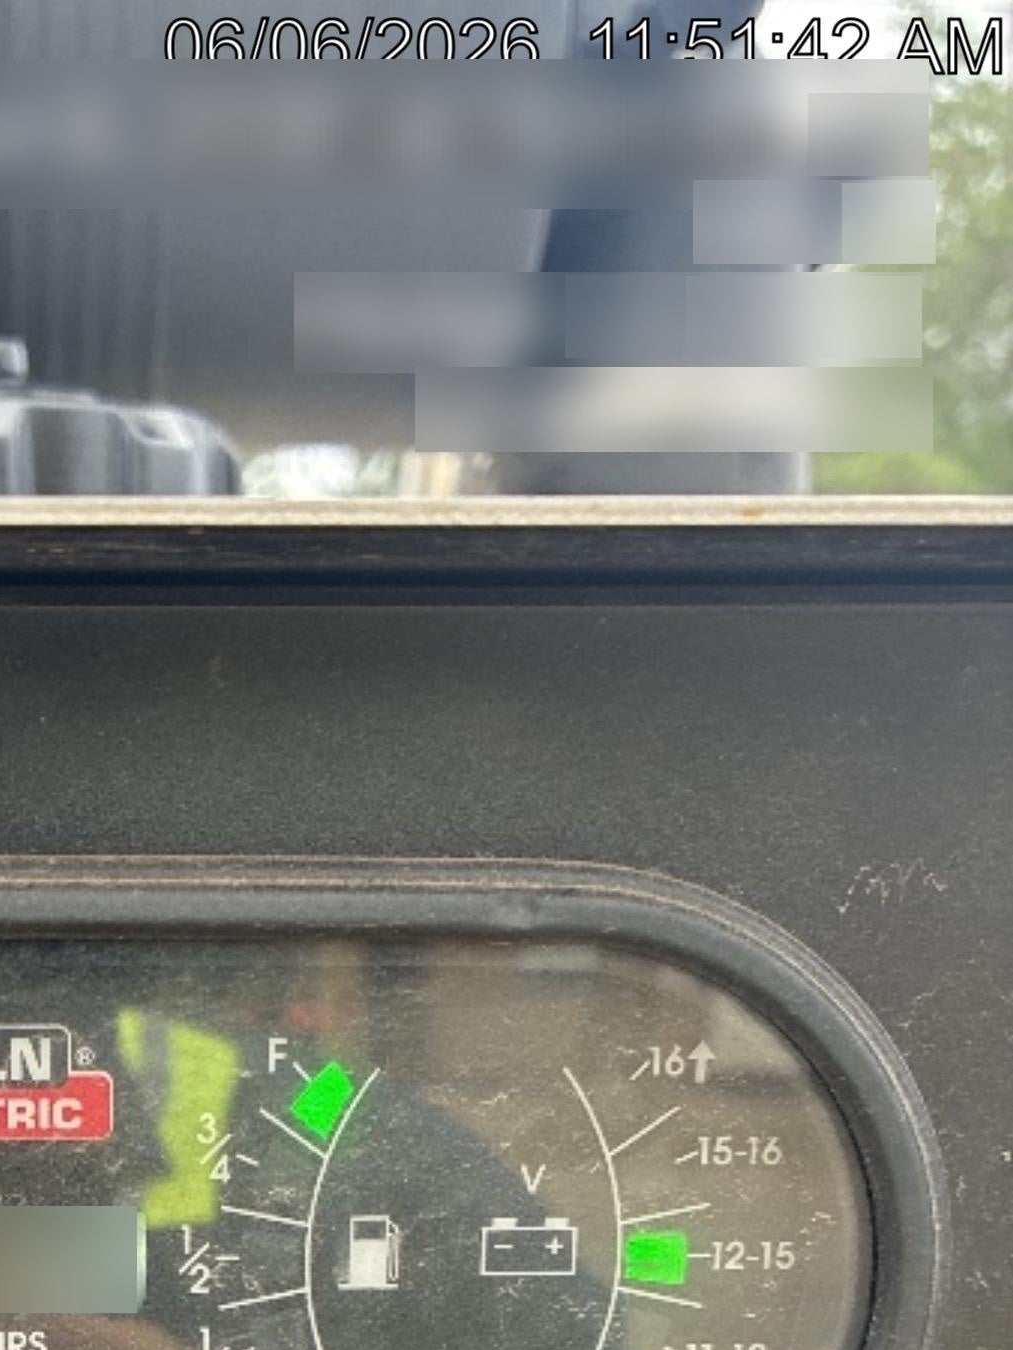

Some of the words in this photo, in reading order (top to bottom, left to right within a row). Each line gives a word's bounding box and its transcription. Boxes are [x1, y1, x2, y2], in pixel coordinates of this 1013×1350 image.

[267, 1037, 289, 1073] F
[649, 1046, 686, 1076] 16
[697, 1136, 783, 1166] 15-16
[520, 1163, 547, 1194] V
[710, 1241, 796, 1271] 12-15
